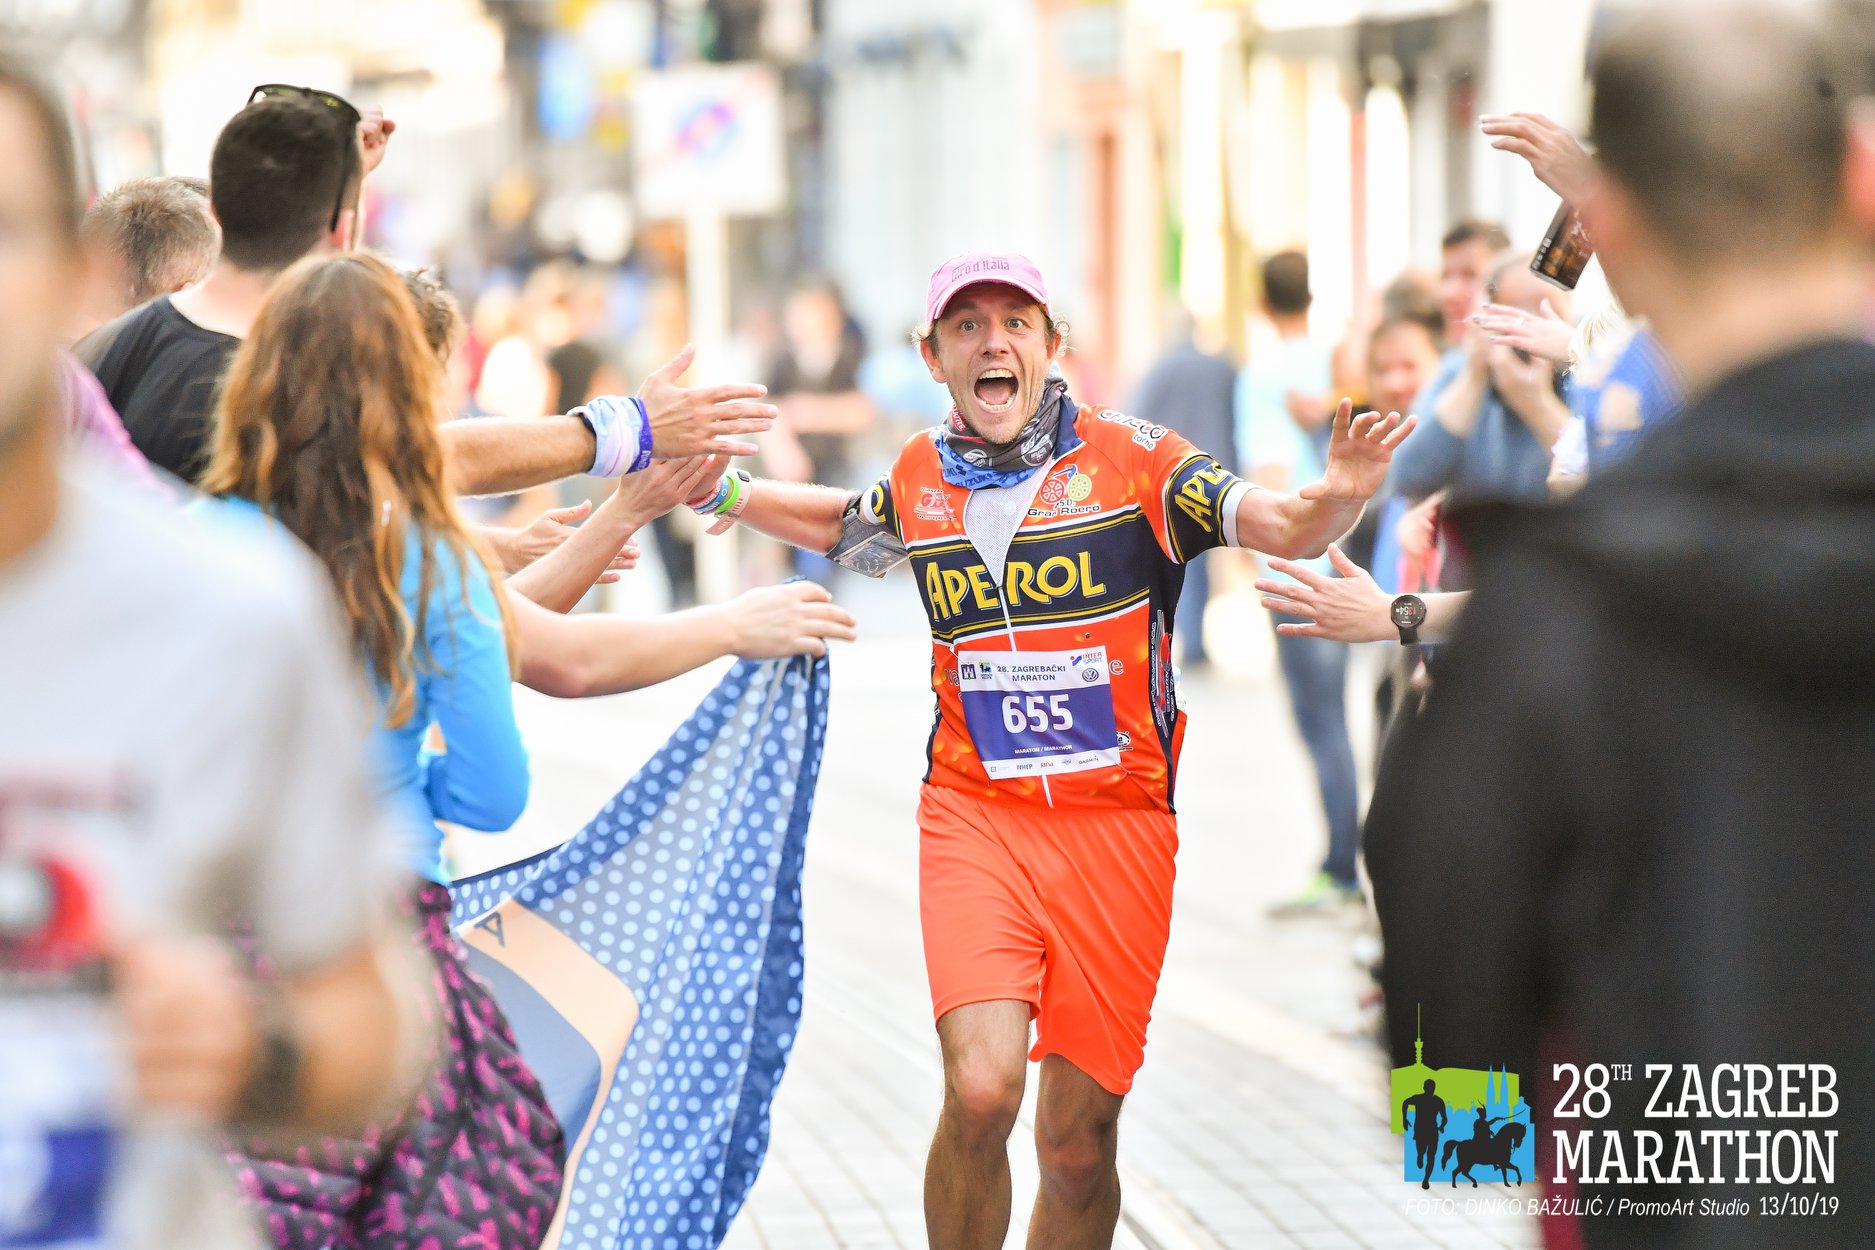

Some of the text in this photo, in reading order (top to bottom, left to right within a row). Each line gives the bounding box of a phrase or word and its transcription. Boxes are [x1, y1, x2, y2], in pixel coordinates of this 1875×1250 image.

[1061, 505, 1100, 515] Roero
[926, 551, 1106, 620] APEROL
[1012, 664, 1066, 672] ZAGREBAČKI
[1001, 694, 1074, 734] 655
